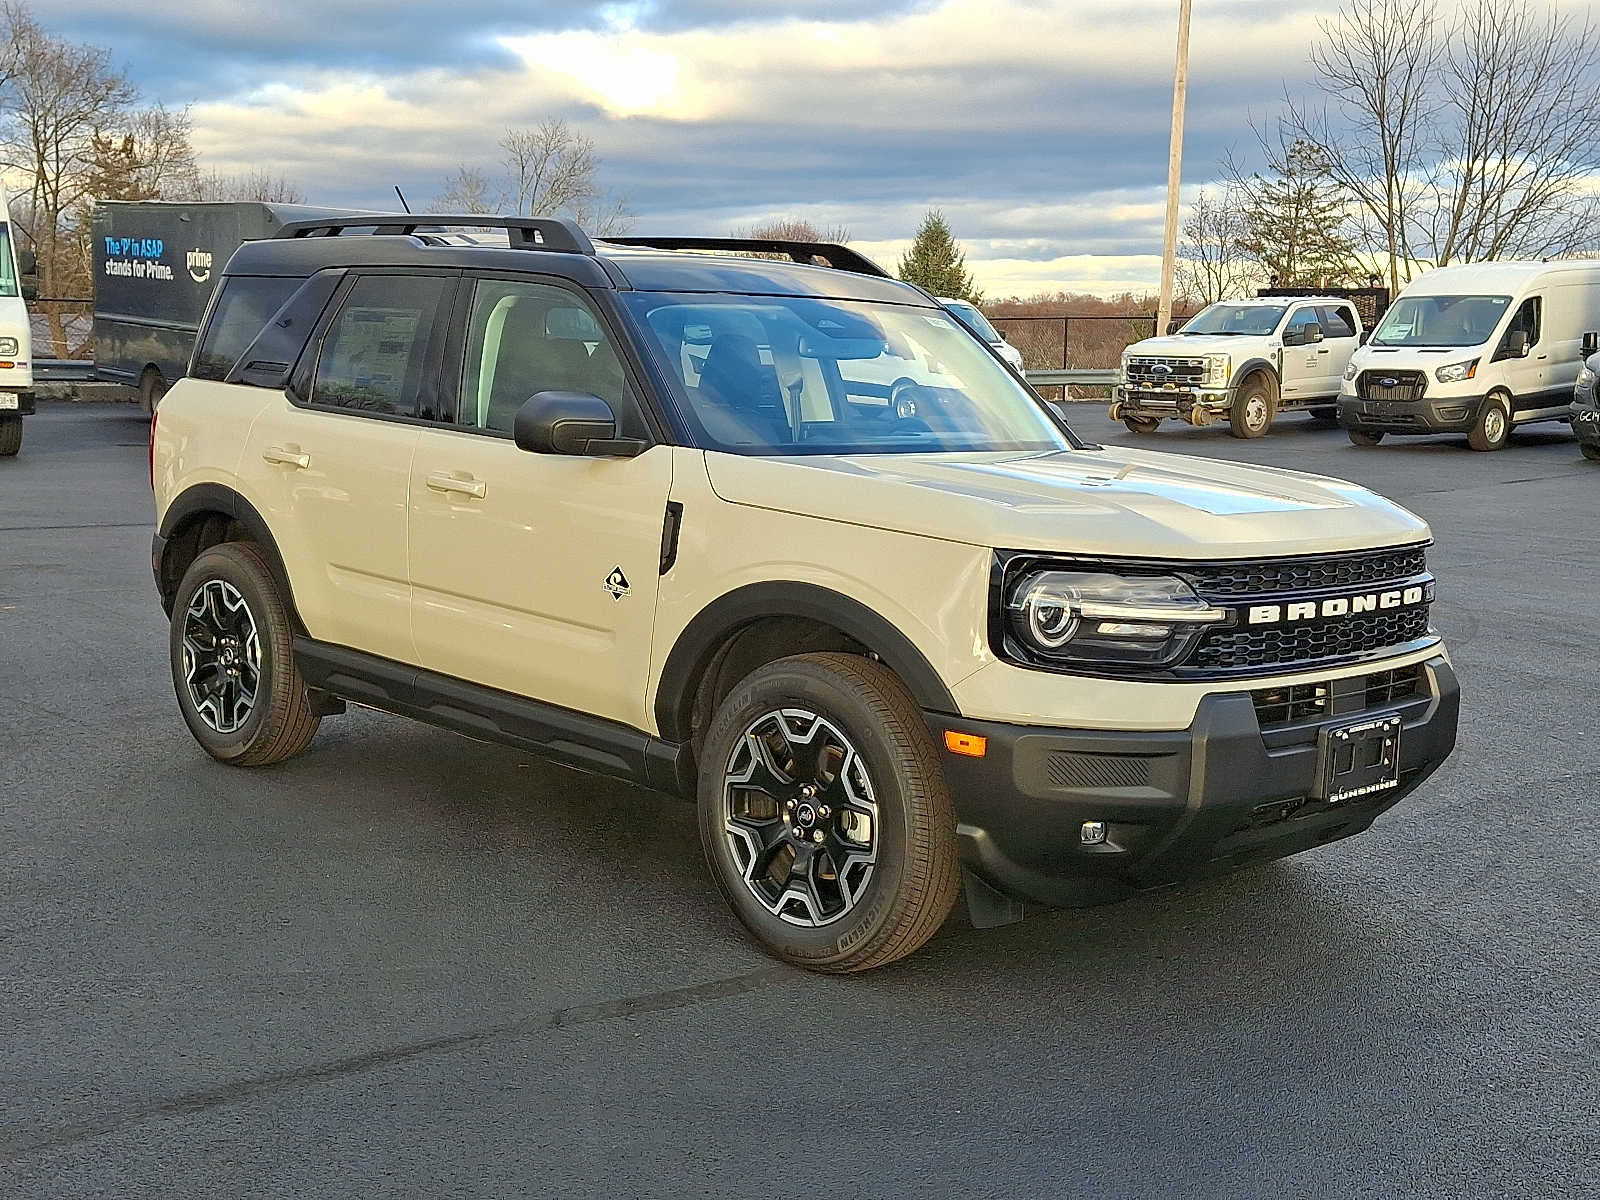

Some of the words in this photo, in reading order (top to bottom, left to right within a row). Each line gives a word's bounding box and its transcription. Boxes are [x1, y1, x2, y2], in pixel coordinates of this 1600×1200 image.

[105, 237, 120, 254] The
[131, 239, 139, 256] in
[140, 239, 163, 257] ASAP
[186, 247, 212, 271] prime
[105, 258, 131, 276] stands
[132, 259, 145, 277] for
[146, 260, 174, 280] Prime.
[1249, 586, 1422, 624] BRONCO
[1329, 779, 1398, 803] SUNSHINE
